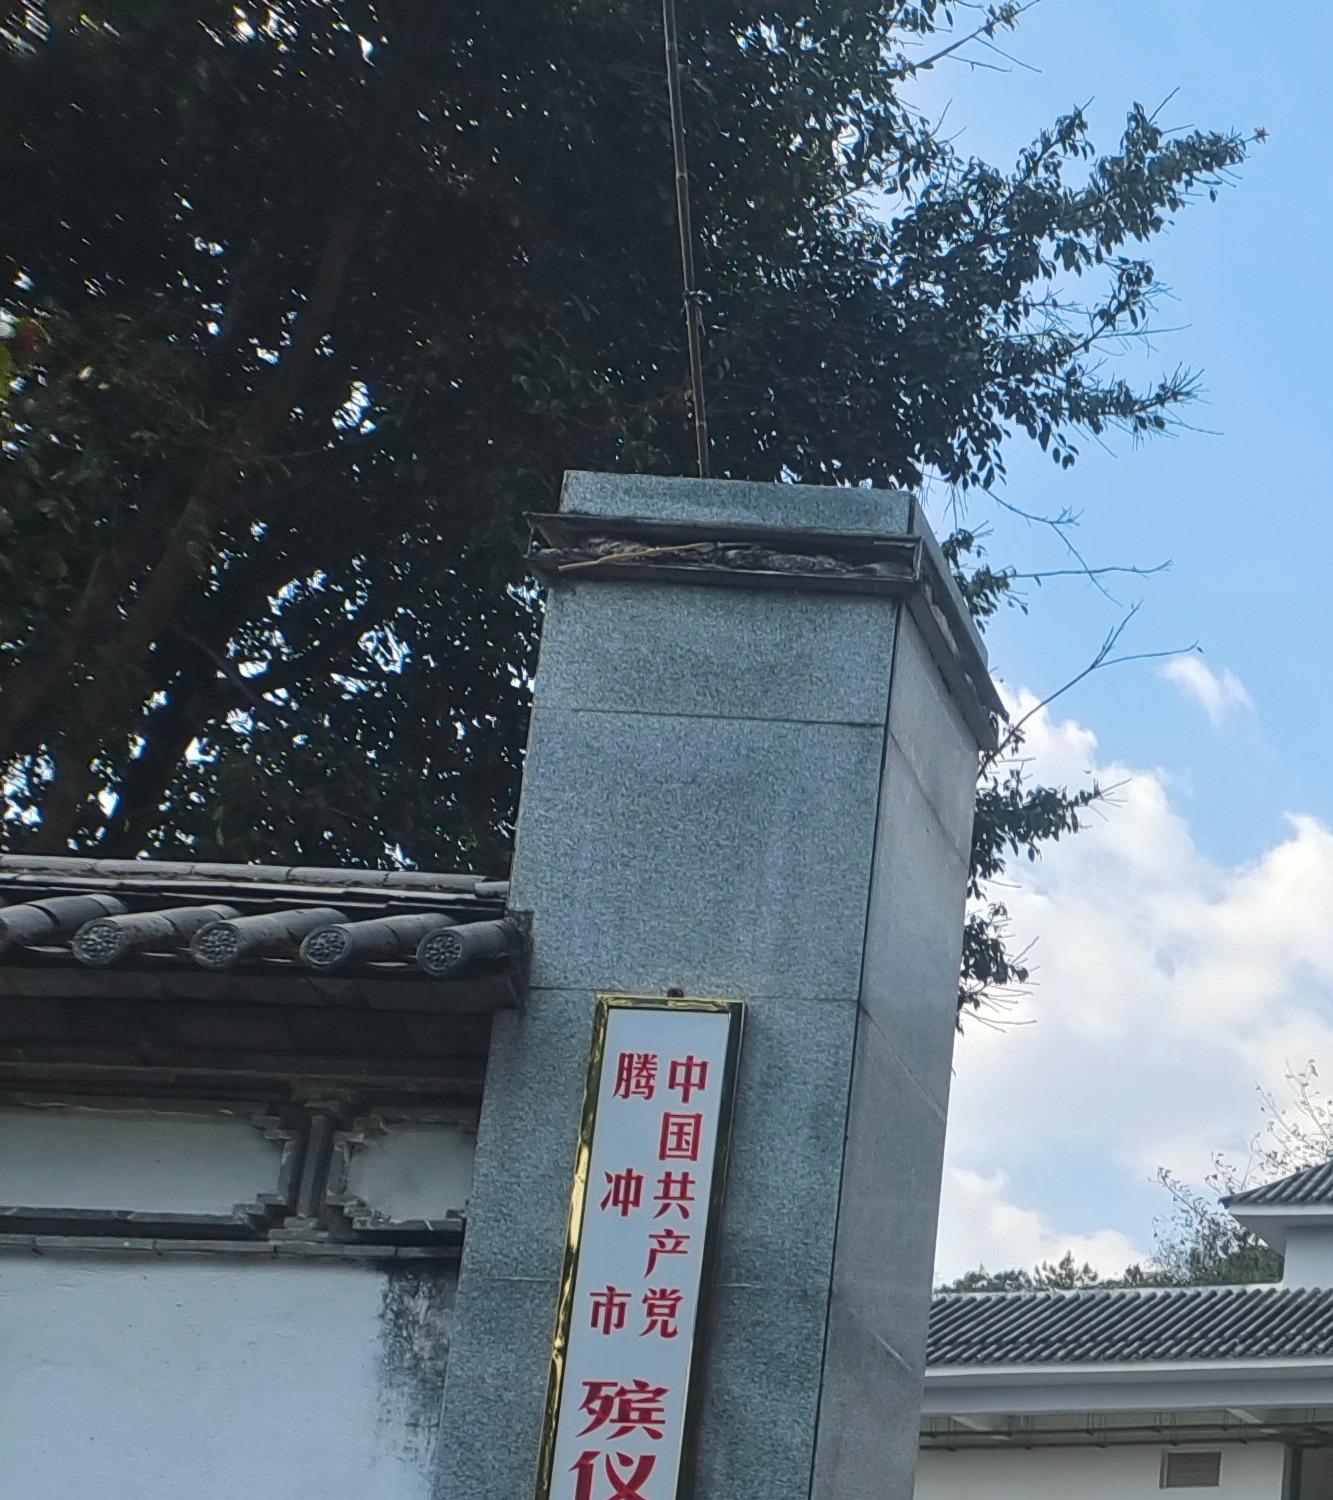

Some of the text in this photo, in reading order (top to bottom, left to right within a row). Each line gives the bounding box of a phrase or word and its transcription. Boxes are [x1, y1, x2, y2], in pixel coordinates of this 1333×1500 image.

[588, 1051, 658, 1336] 腾冲市
[638, 1052, 709, 1339] 中国共产党
